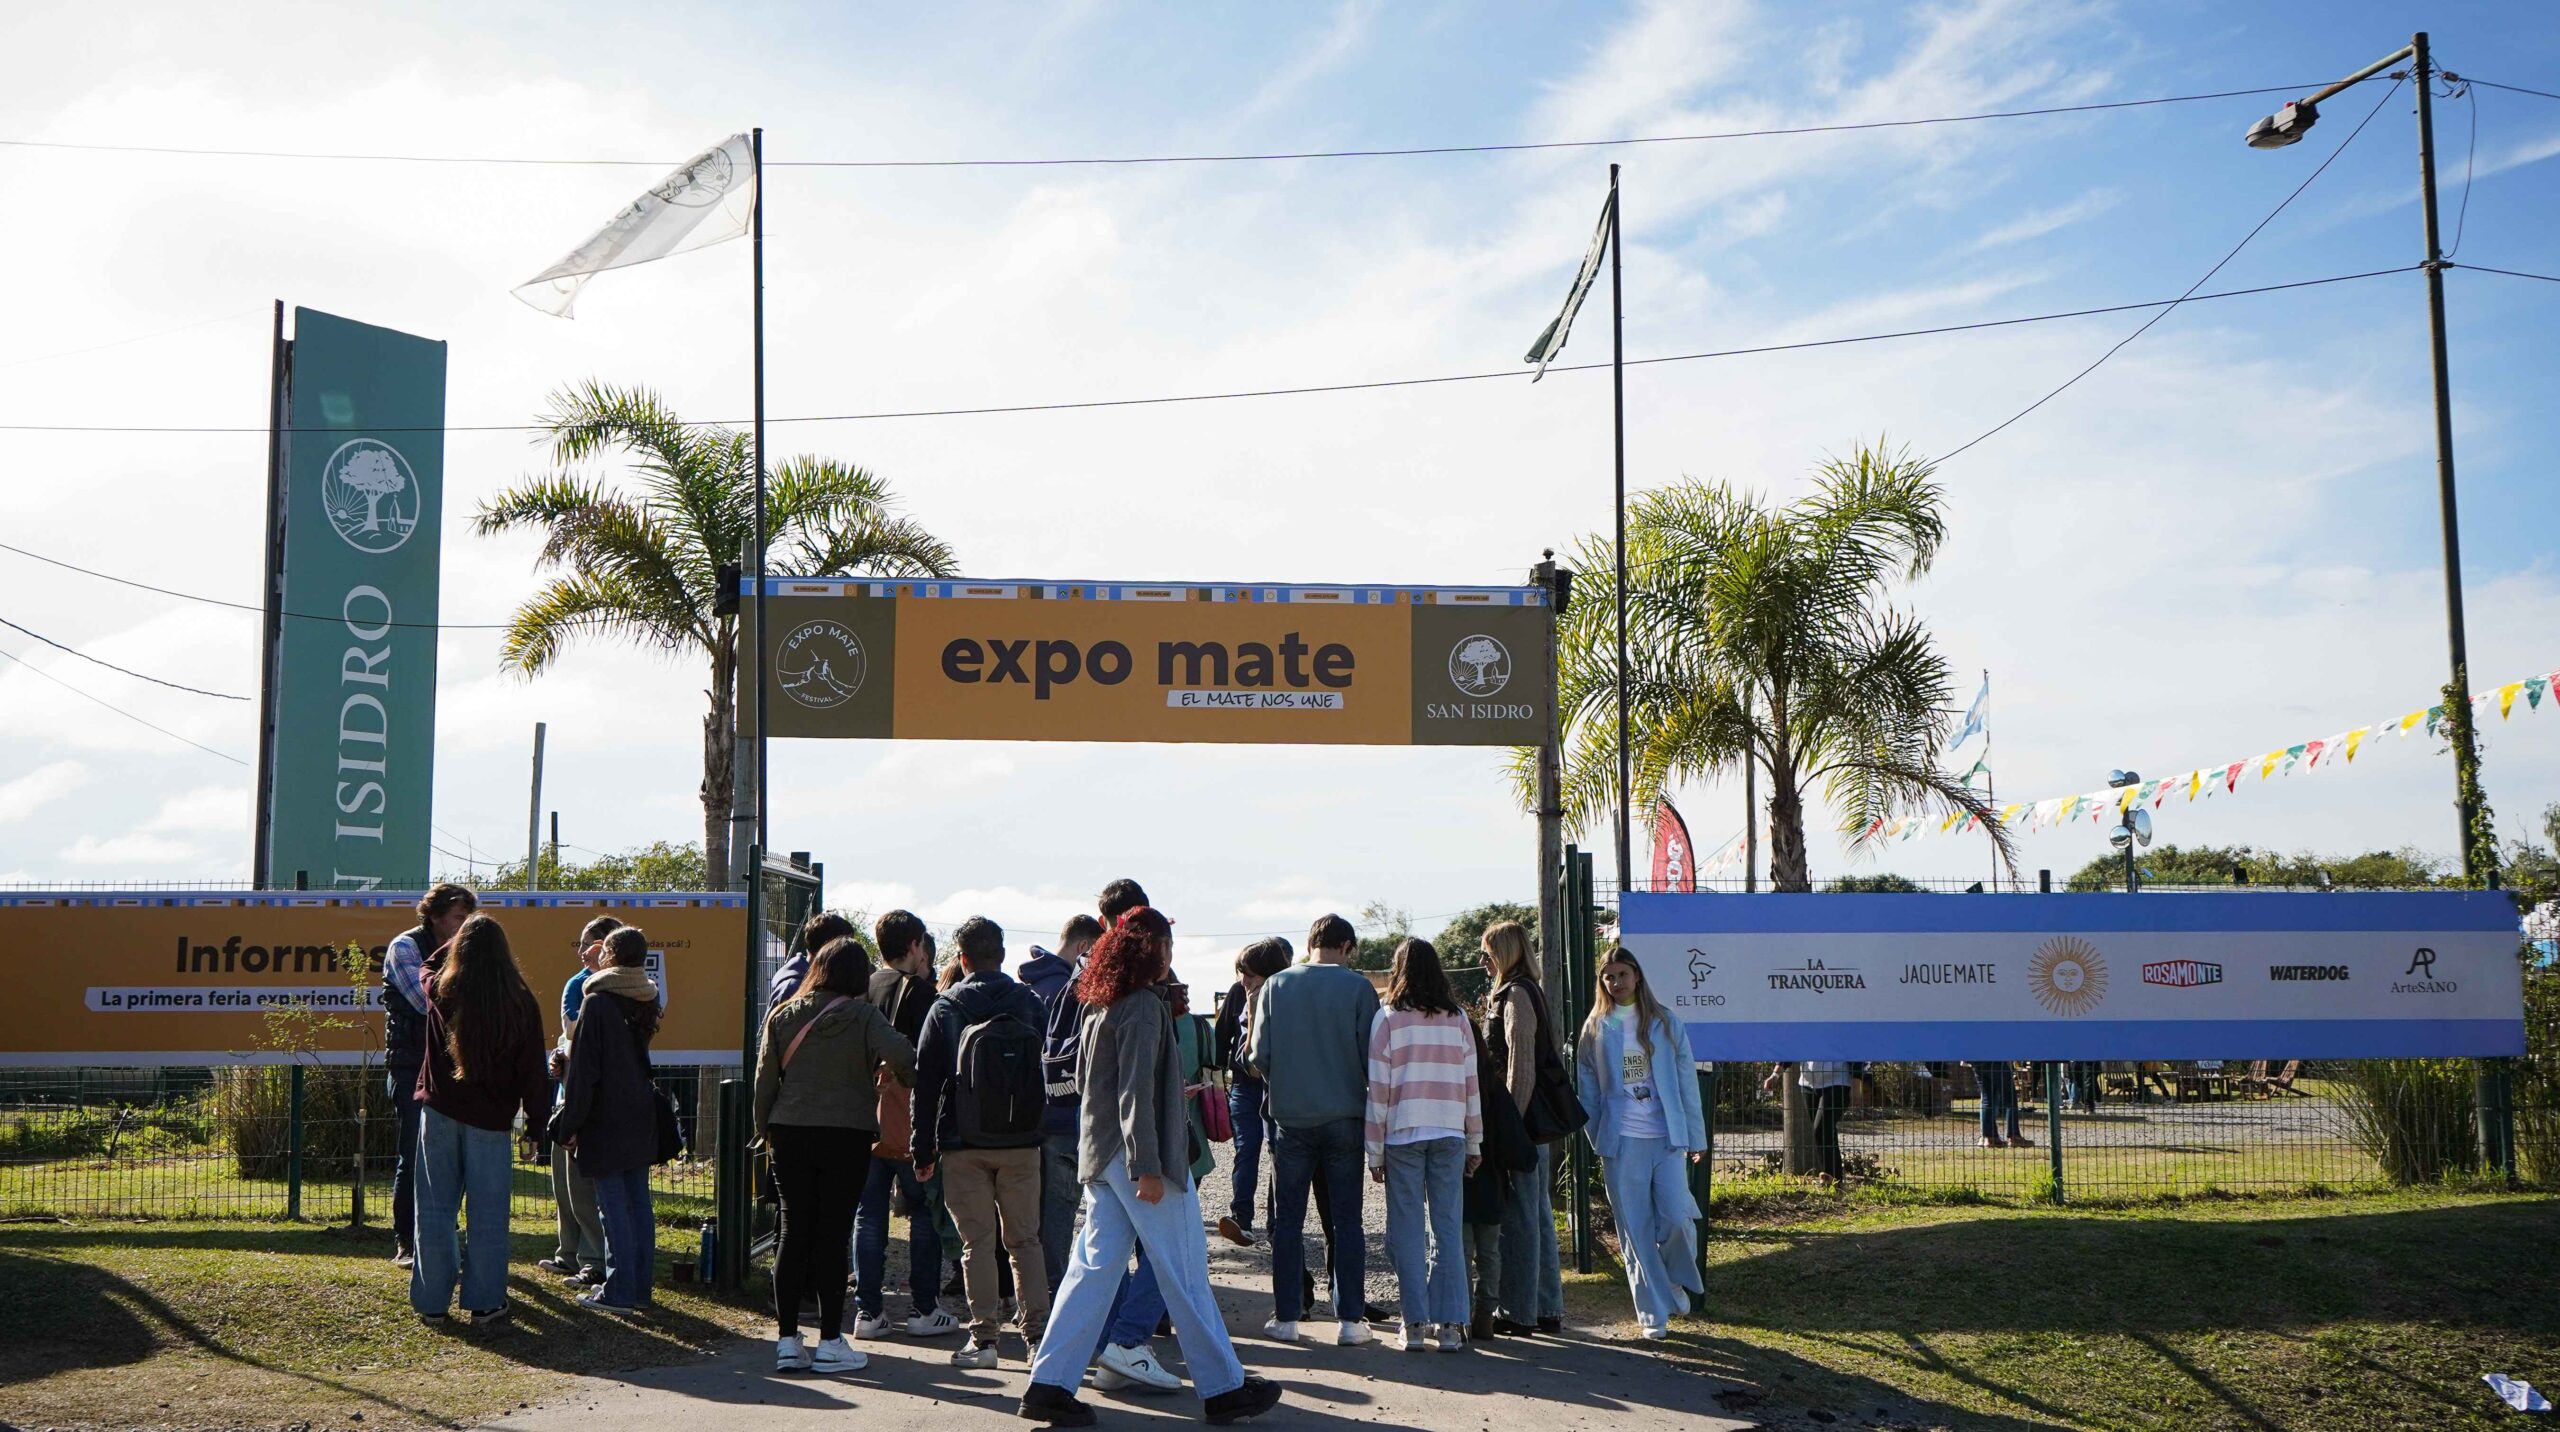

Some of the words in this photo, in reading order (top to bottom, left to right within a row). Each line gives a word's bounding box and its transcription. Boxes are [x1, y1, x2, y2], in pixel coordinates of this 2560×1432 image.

[788, 625, 824, 650] EXPO
[828, 626, 859, 657] MATE
[941, 638, 1133, 700] expo
[1158, 631, 1355, 688] mate
[800, 692, 833, 704] FESTIVAL
[1181, 692, 1201, 706] EL
[1207, 692, 1255, 706] MATE
[1261, 693, 1294, 708] NOS
[1301, 694, 1335, 708] UNE
[334, 583, 393, 845] ISIDRO
[1427, 703, 1465, 719] SAN
[1471, 703, 1534, 720] ISIDRO
[1807, 958, 1825, 972] LA
[1899, 963, 1996, 984] JAQUEMATE
[2270, 965, 2349, 981] WATERDOG
[1768, 974, 1866, 993] TRANQUERA
[2144, 963, 2221, 986] ROSAMONTE
[2391, 981, 2457, 993] ArteSANO
[101, 991, 122, 1006] La
[127, 990, 203, 1010] primera
[209, 990, 251, 1006] feria
[1676, 995, 1690, 1007] EL
[1693, 995, 1726, 1007] TERO
